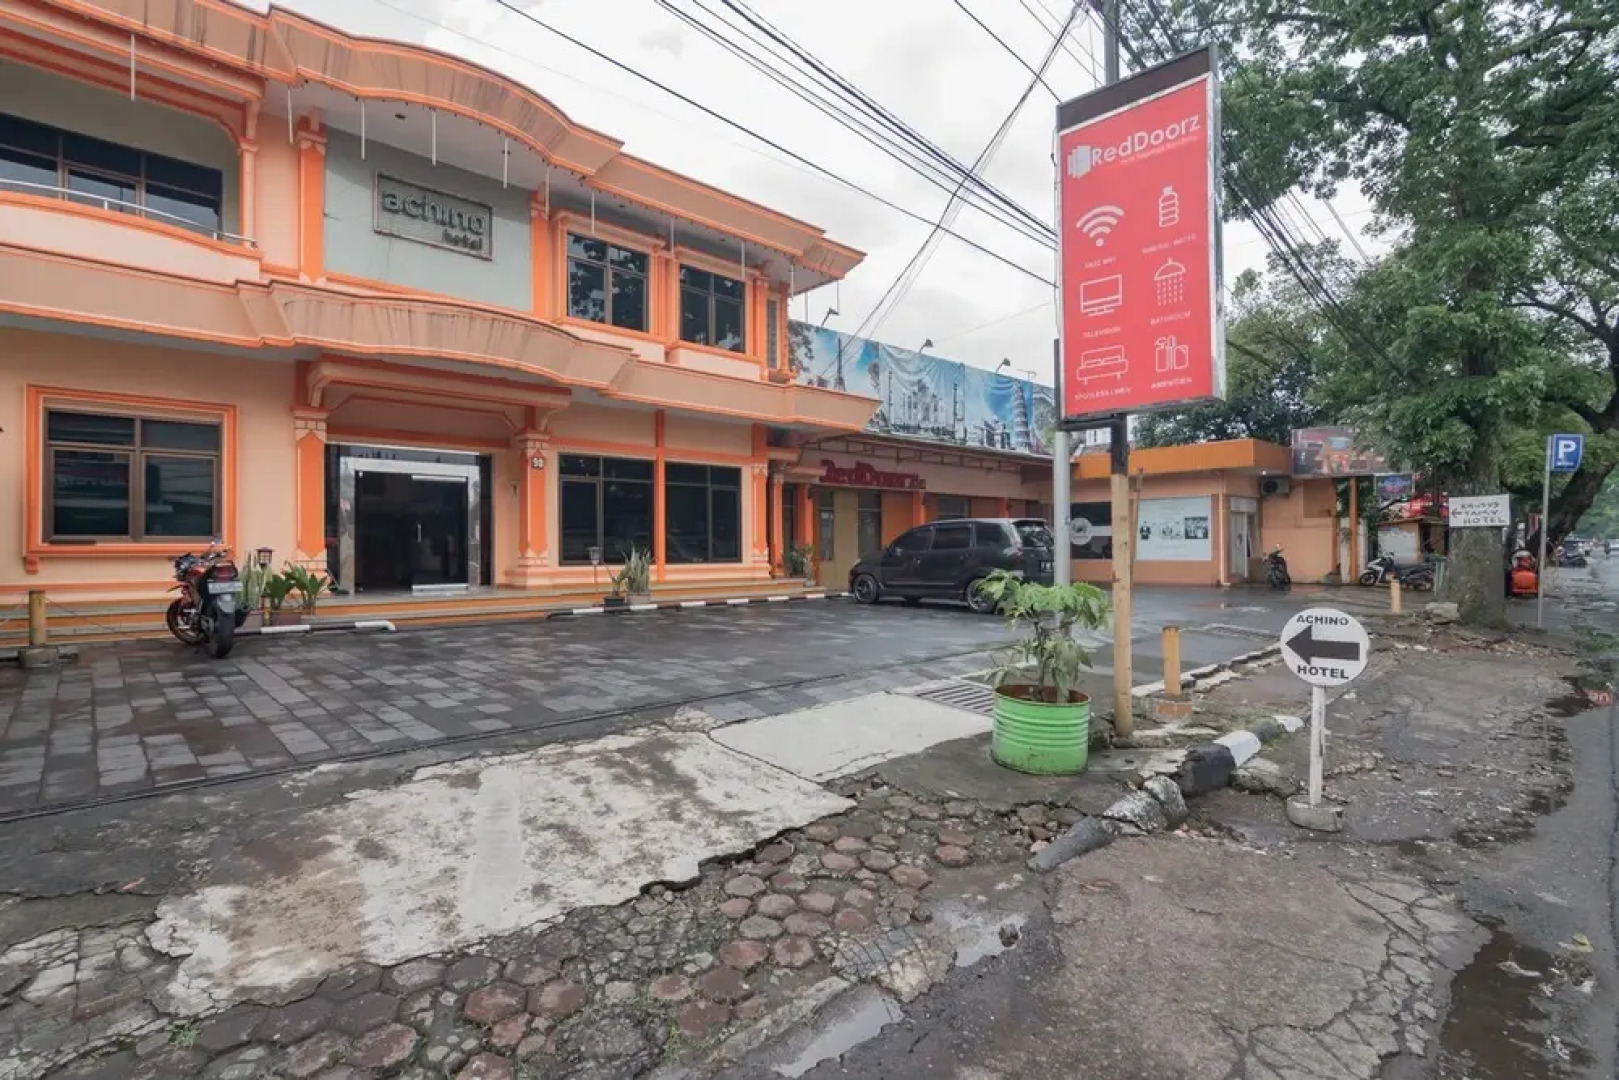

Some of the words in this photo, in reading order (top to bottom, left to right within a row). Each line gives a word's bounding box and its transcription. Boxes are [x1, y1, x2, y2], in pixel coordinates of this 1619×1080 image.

[1092, 115, 1201, 166] RedDoorz
[382, 190, 486, 236] achino
[1558, 440, 1576, 459] P
[1463, 516, 1505, 524] HOTEL
[1296, 614, 1349, 626] ACHINO
[1297, 665, 1349, 679] HOTEL
